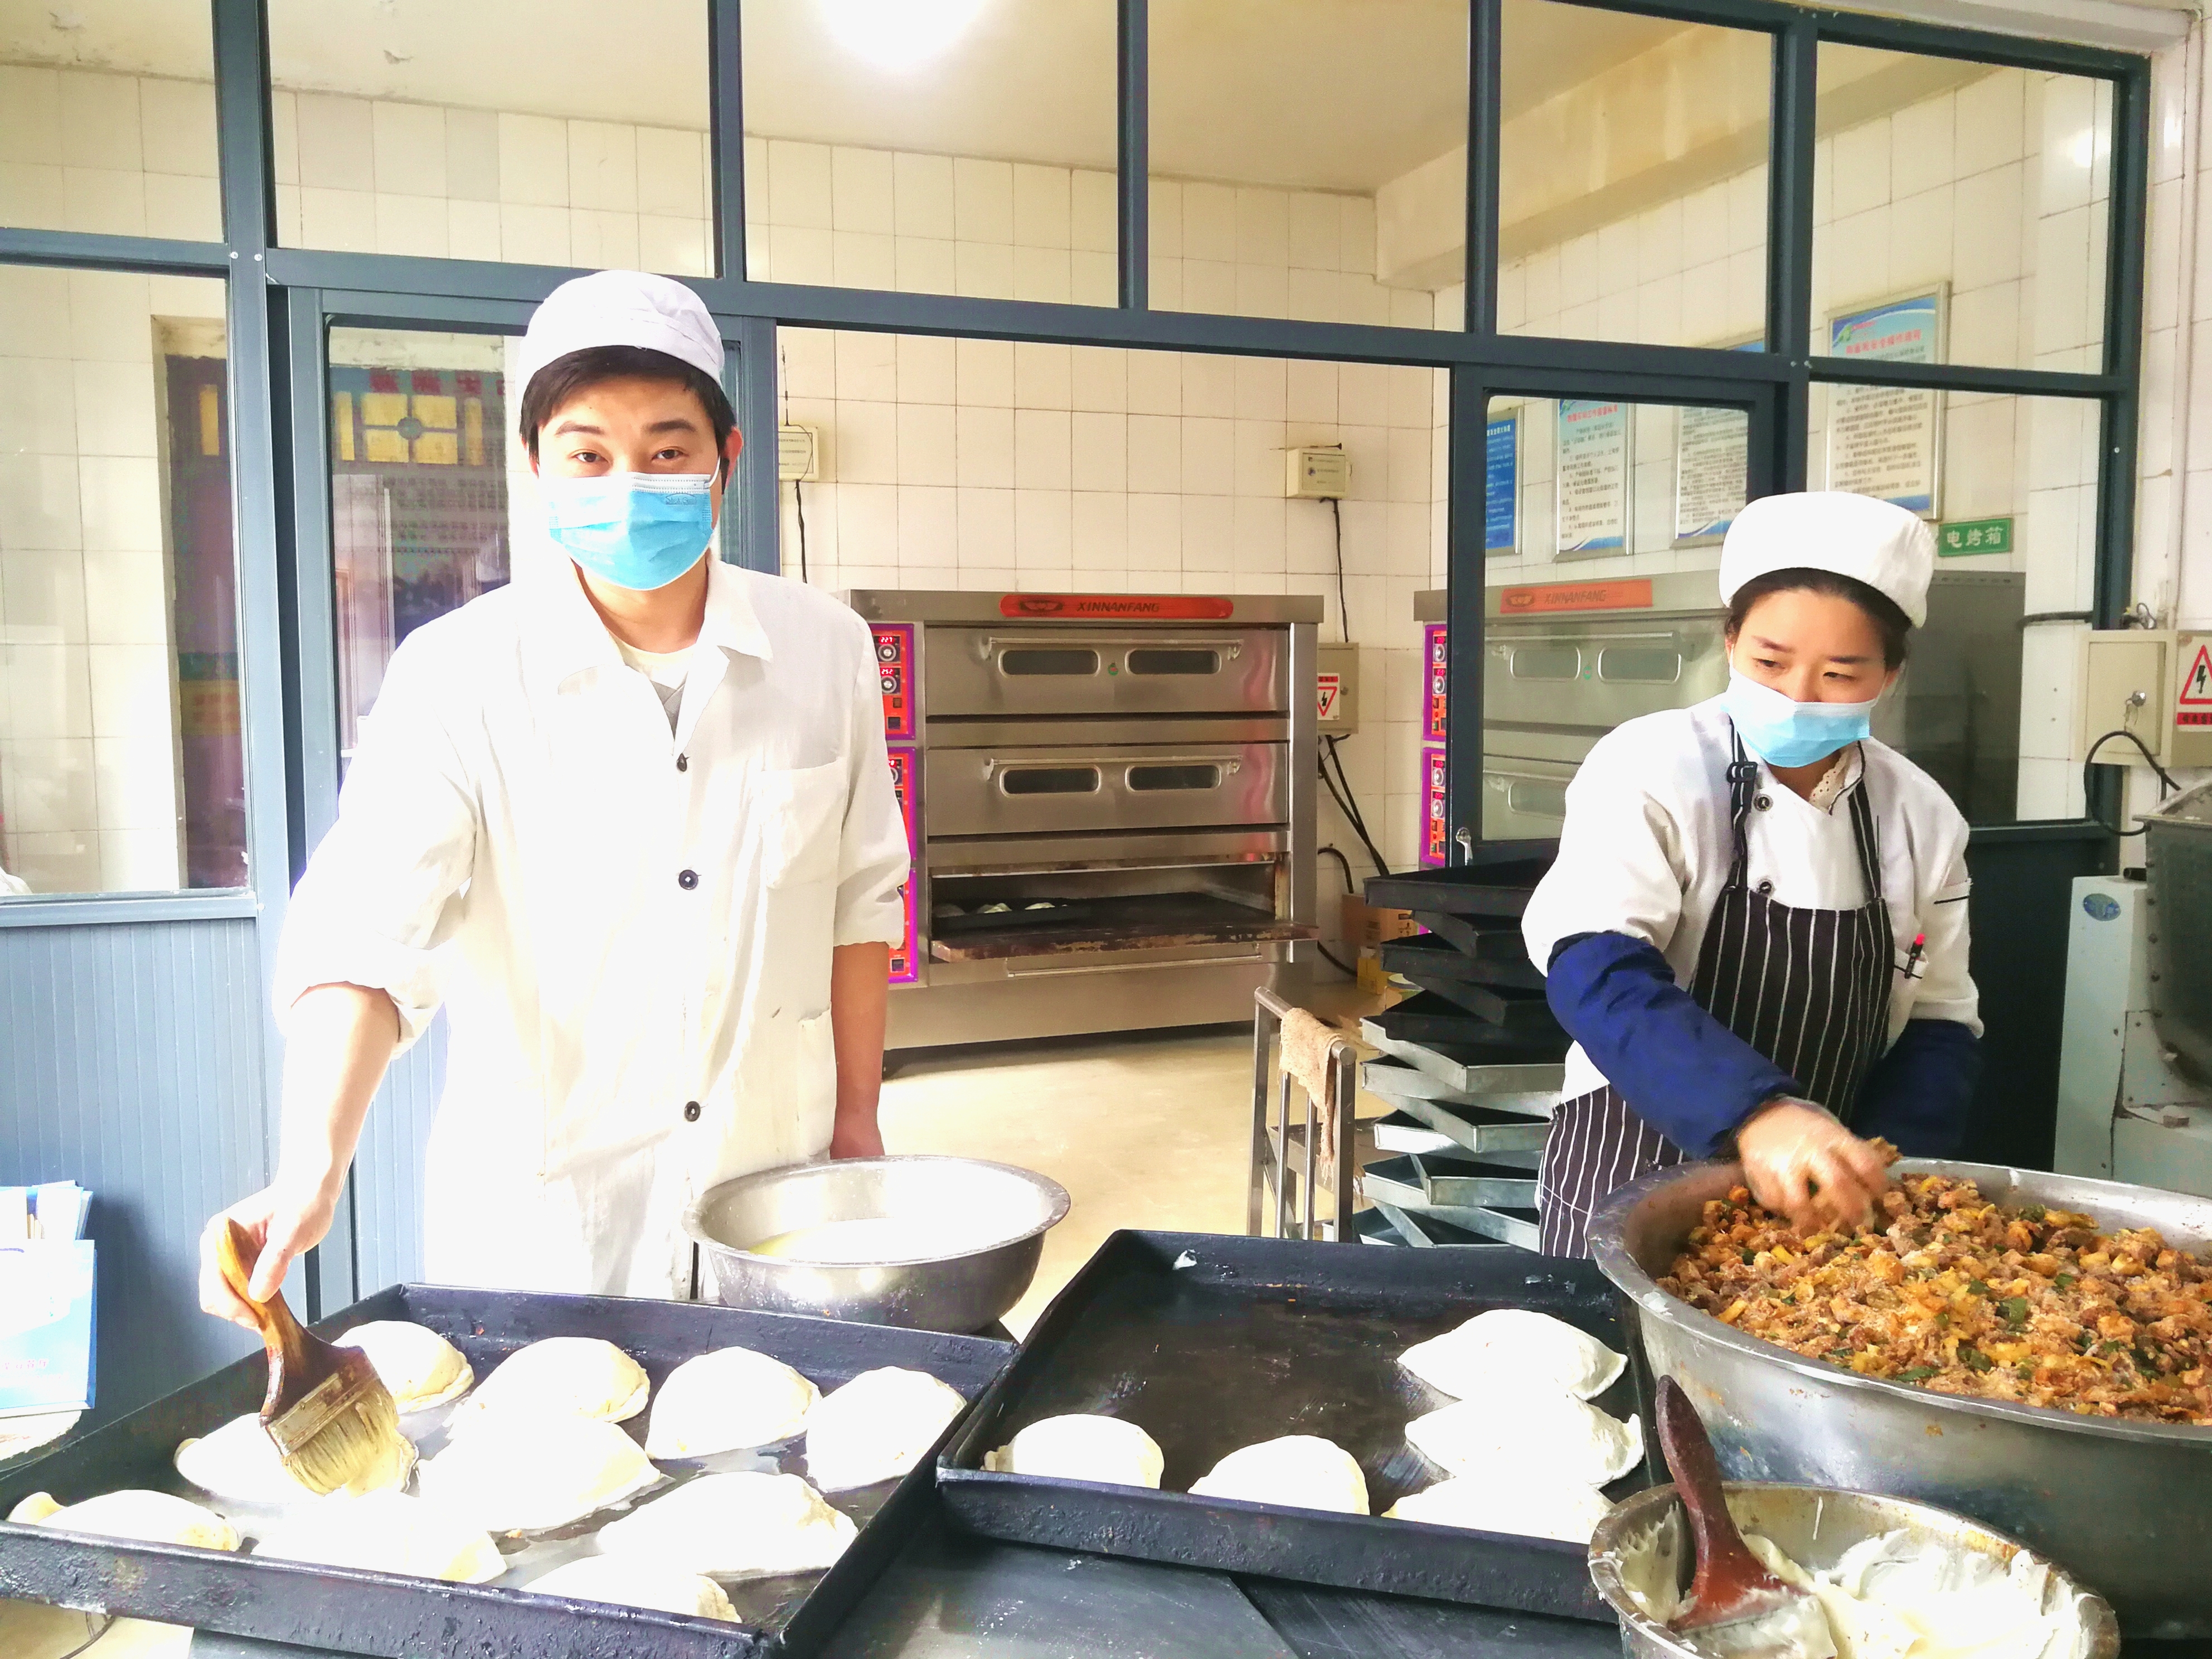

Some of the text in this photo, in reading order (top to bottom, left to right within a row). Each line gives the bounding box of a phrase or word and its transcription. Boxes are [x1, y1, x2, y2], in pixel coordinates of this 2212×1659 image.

[1947, 526, 2004, 549] 电烤箱
[1545, 589, 1607, 604] XINNANFANG
[1077, 602, 1160, 612] XINNANFANG
